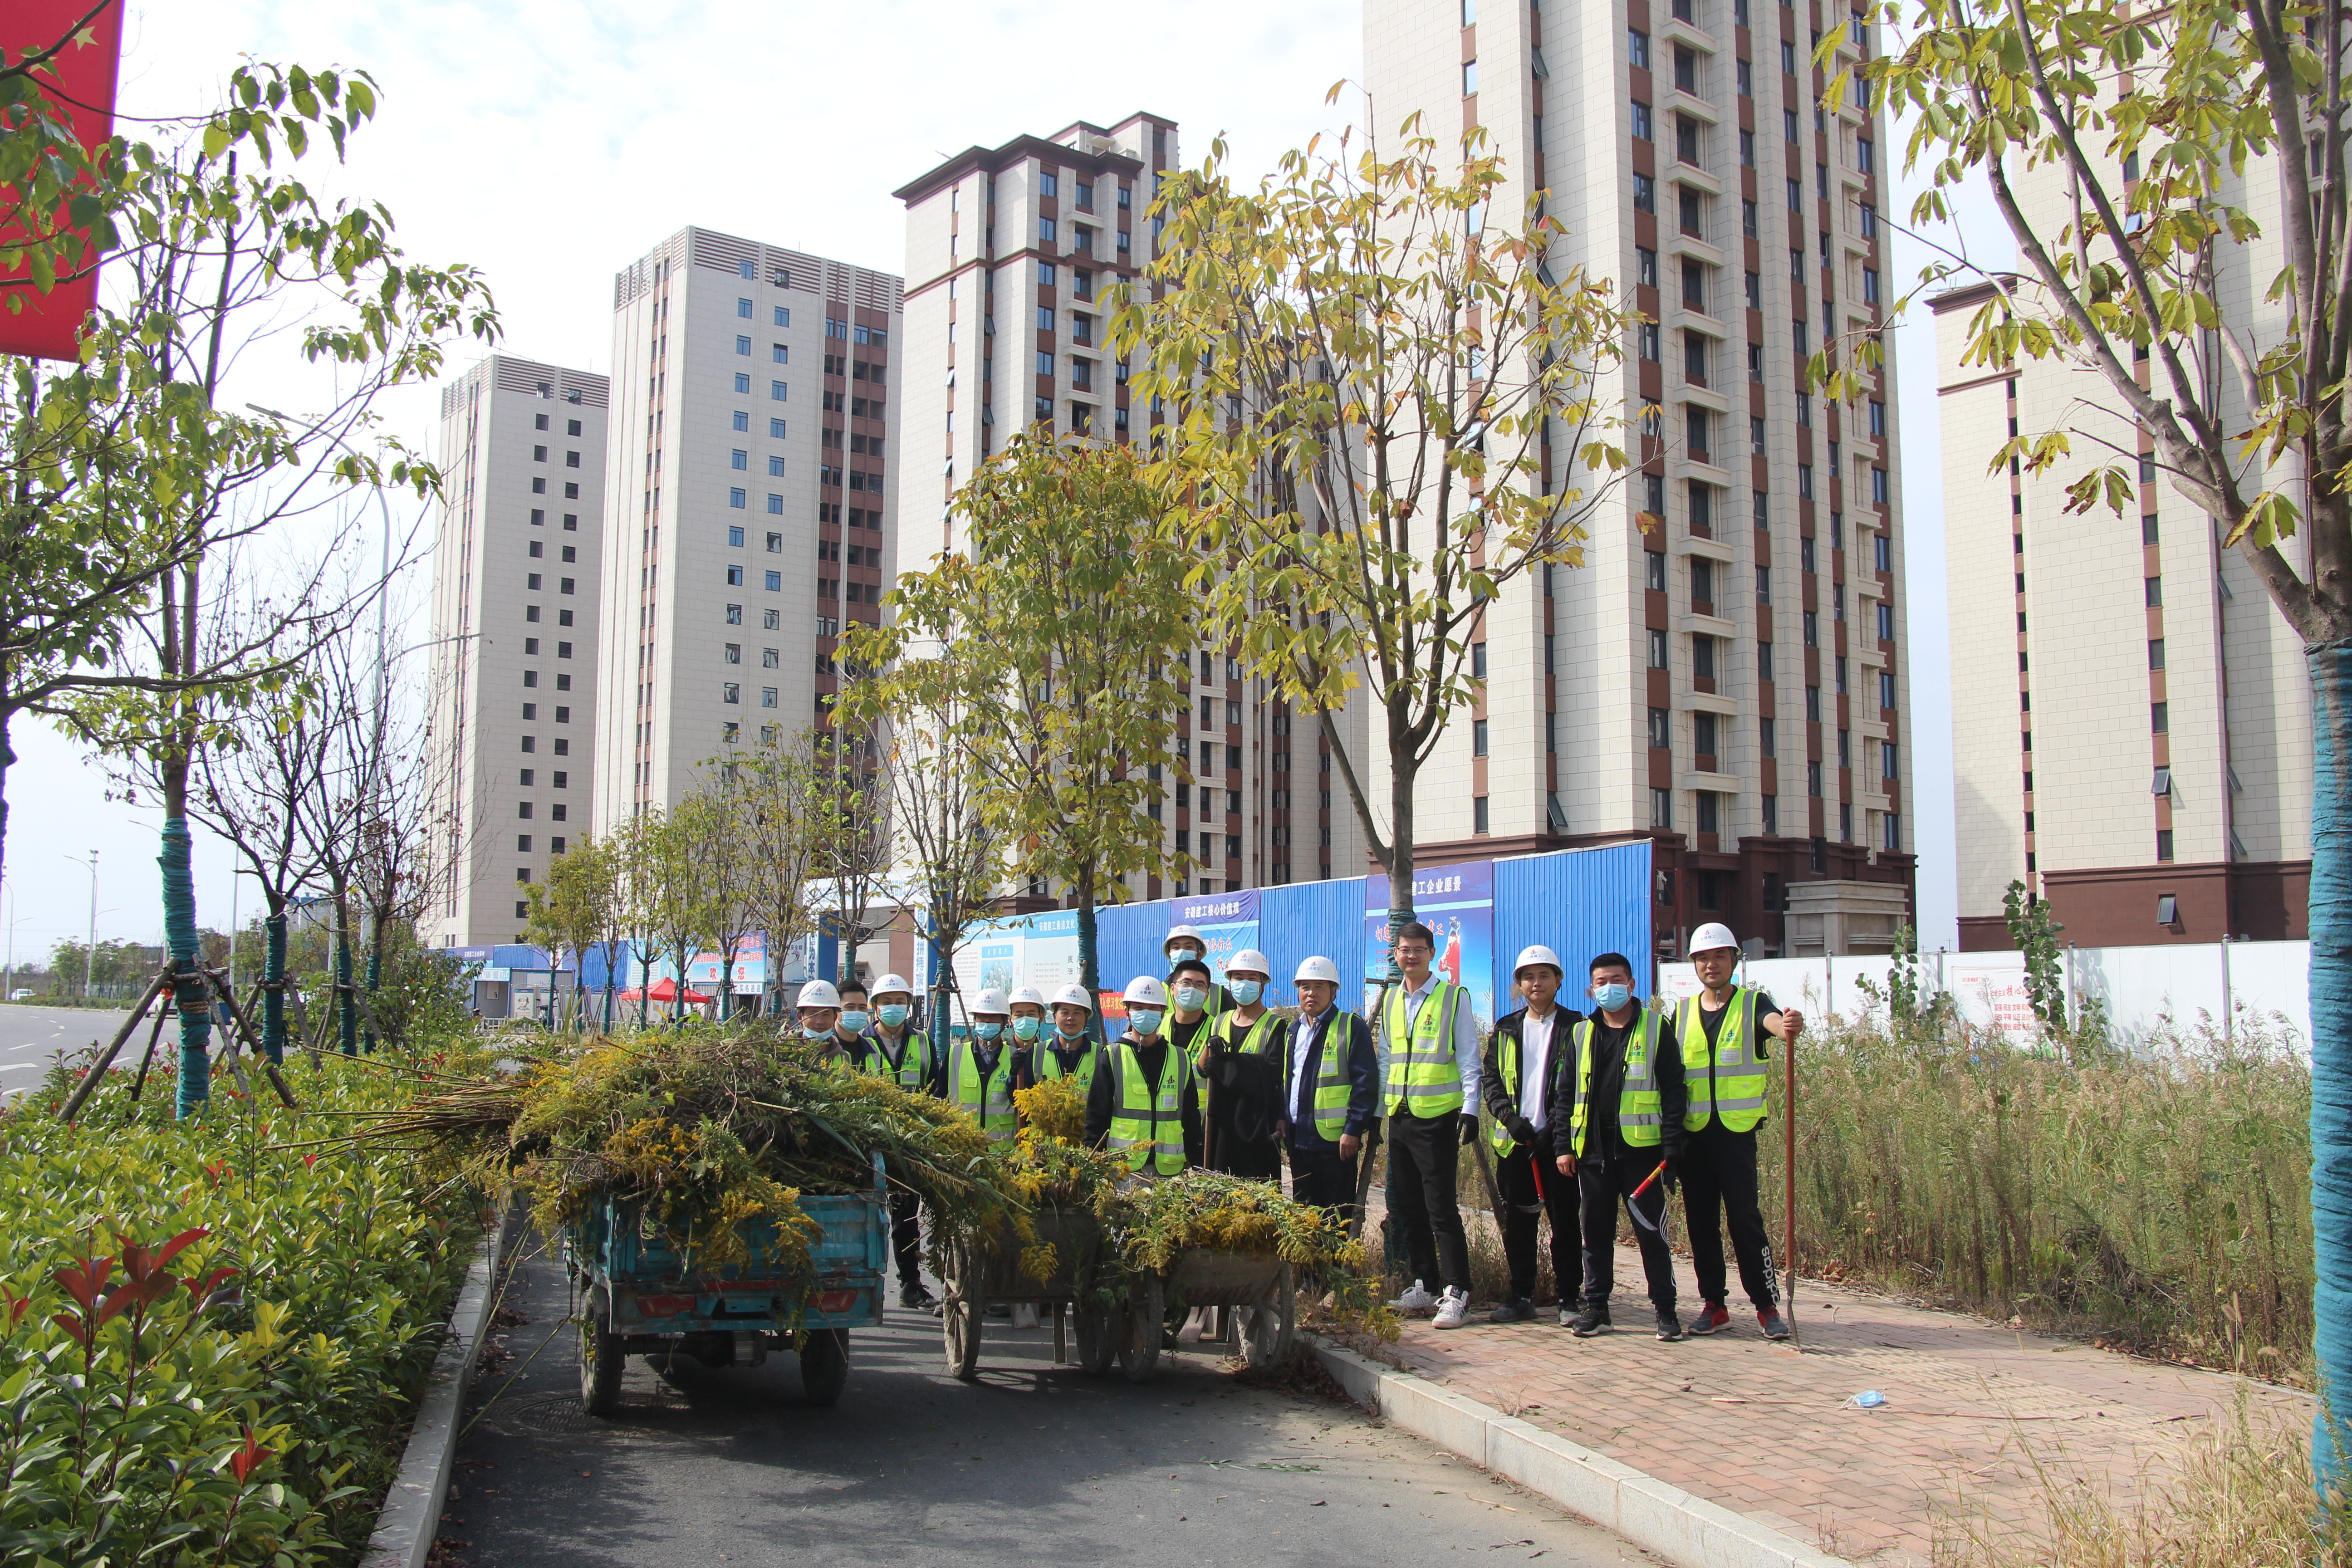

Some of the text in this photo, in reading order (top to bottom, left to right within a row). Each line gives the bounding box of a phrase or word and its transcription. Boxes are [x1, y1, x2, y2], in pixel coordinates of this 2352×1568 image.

[1185, 902, 1240, 919] 安徽建工核心价值观
[1039, 918, 1075, 932] 安徽建工廉洁文化
[1761, 1245, 1780, 1304] adidas
